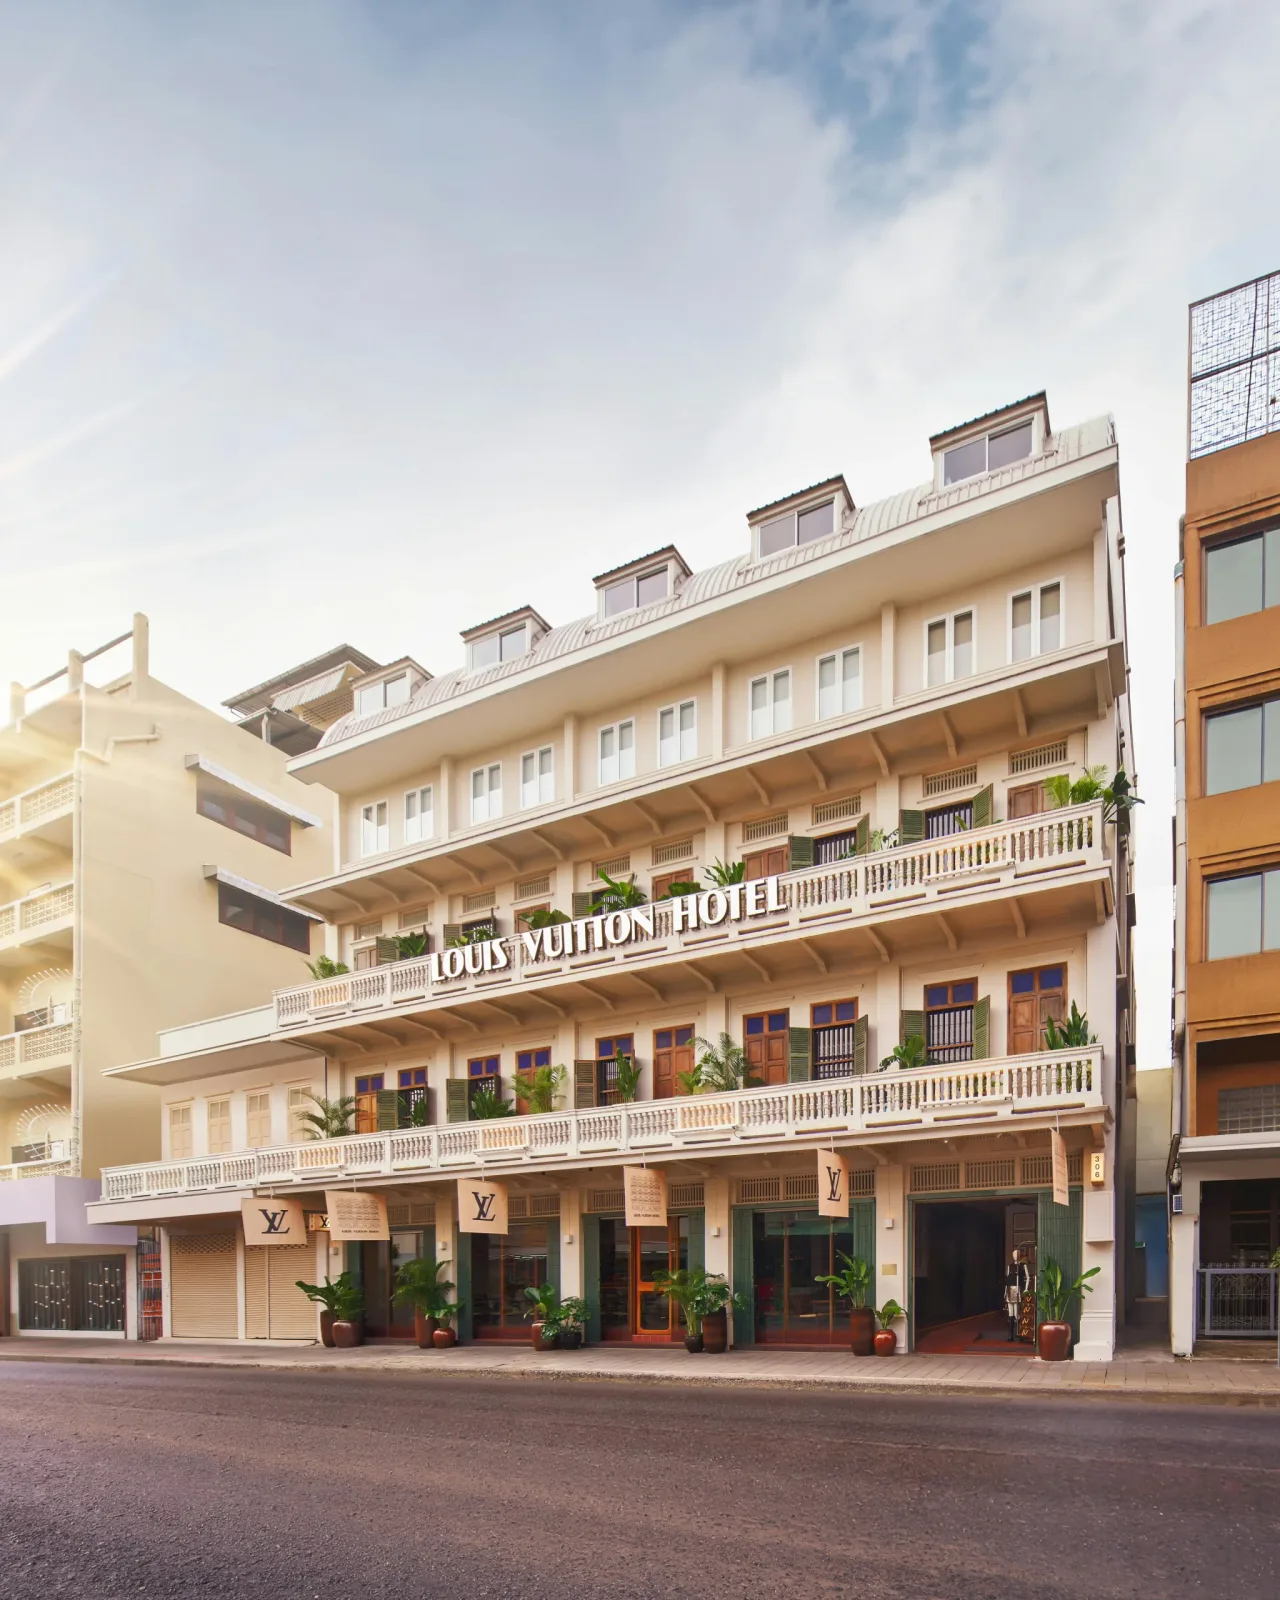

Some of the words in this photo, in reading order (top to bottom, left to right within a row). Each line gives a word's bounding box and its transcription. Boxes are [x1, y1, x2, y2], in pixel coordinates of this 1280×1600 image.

[431, 938, 508, 982] LOUIS
[523, 905, 654, 961] VUITTON
[674, 876, 787, 931] HOTEL
